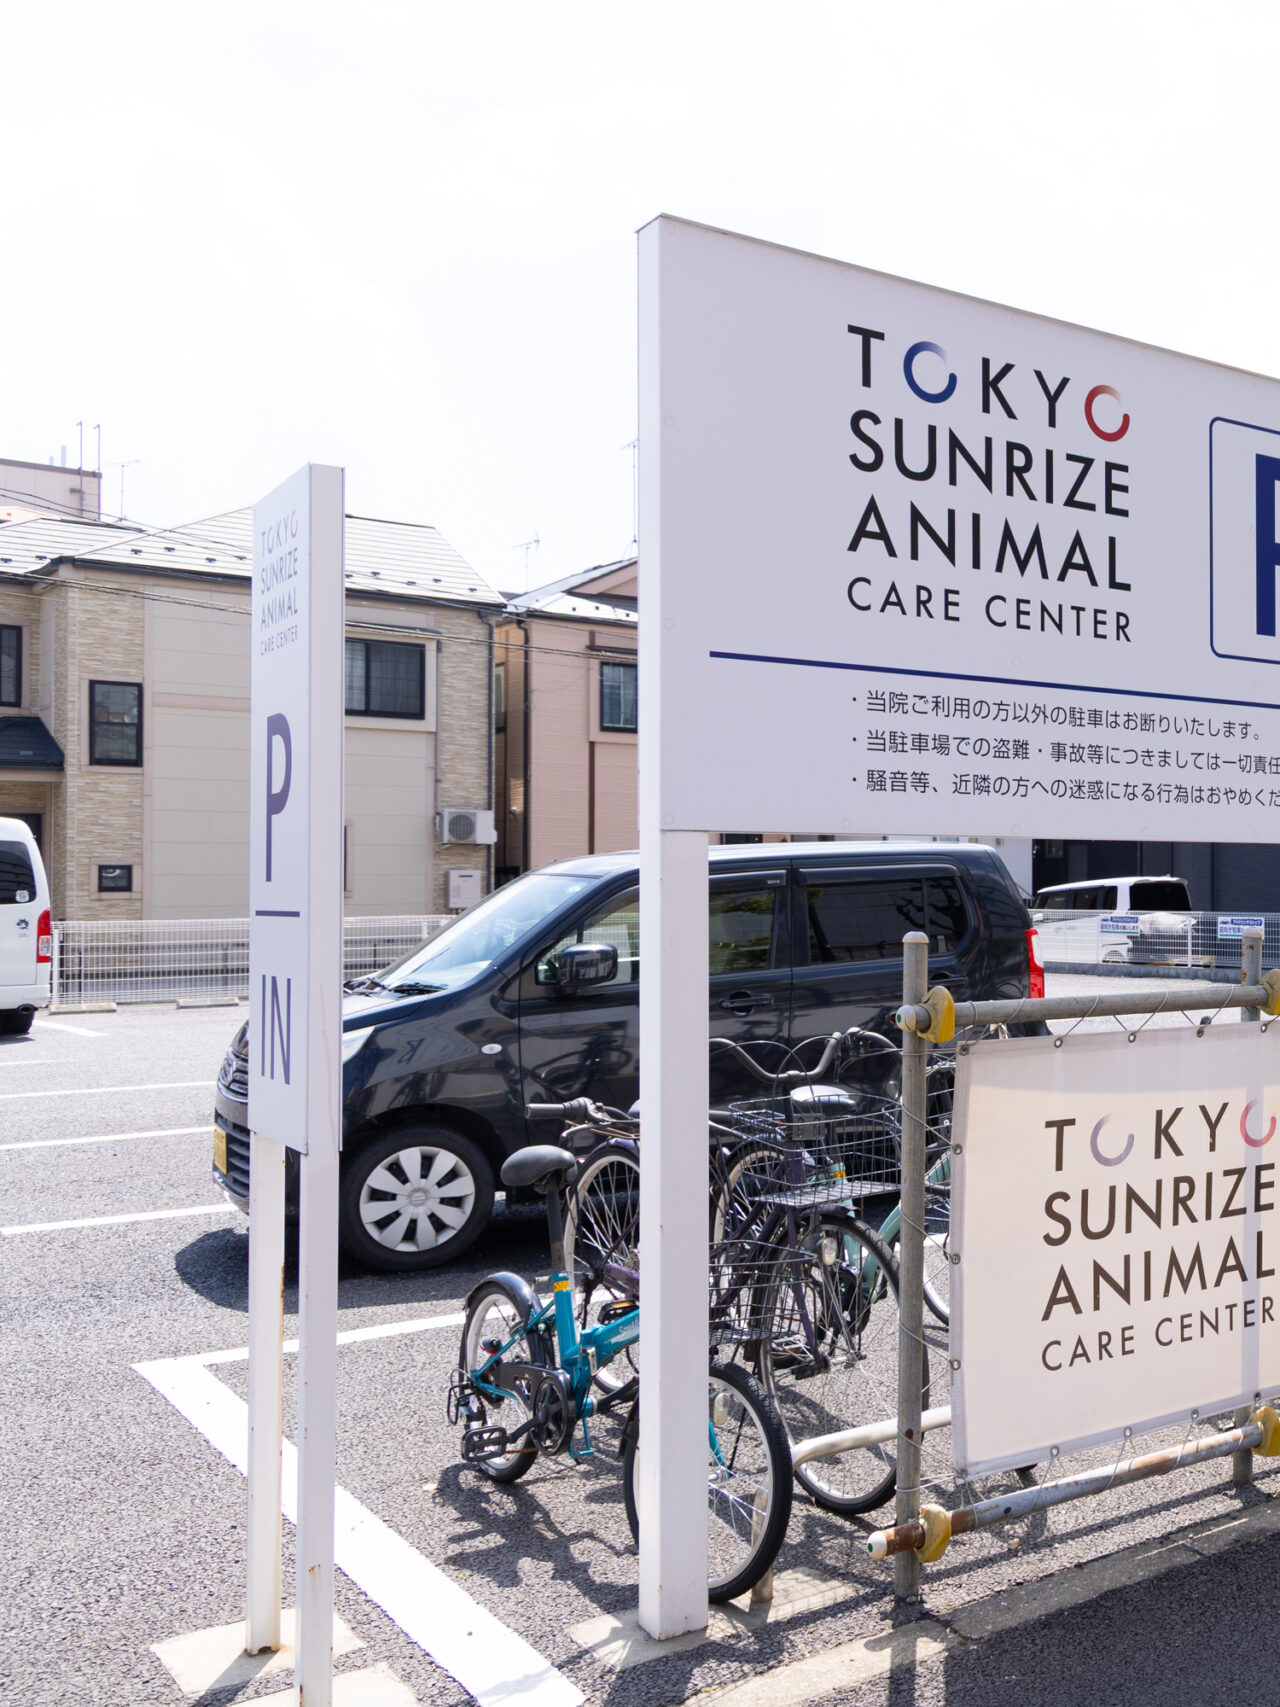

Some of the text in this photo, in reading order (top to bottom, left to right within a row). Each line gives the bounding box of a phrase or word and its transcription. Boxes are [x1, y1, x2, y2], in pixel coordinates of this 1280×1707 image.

[848, 324, 1130, 442] TOKYO
[848, 410, 1130, 518] SUNRIZE
[261, 509, 298, 558] TOKYO
[261, 547, 298, 595] SUNRIZE
[847, 494, 1131, 592] ANIMAL
[261, 587, 298, 632] ANIMAL
[847, 577, 1131, 642] CARE CENTER
[266, 713, 292, 882] P
[261, 974, 291, 1085] IN
[1045, 1099, 1277, 1172] TOKYO
[1043, 1163, 1275, 1246] SUNRIZE
[1041, 1230, 1275, 1321] ANIMAL
[1042, 1296, 1275, 1371] CARE CENTER
